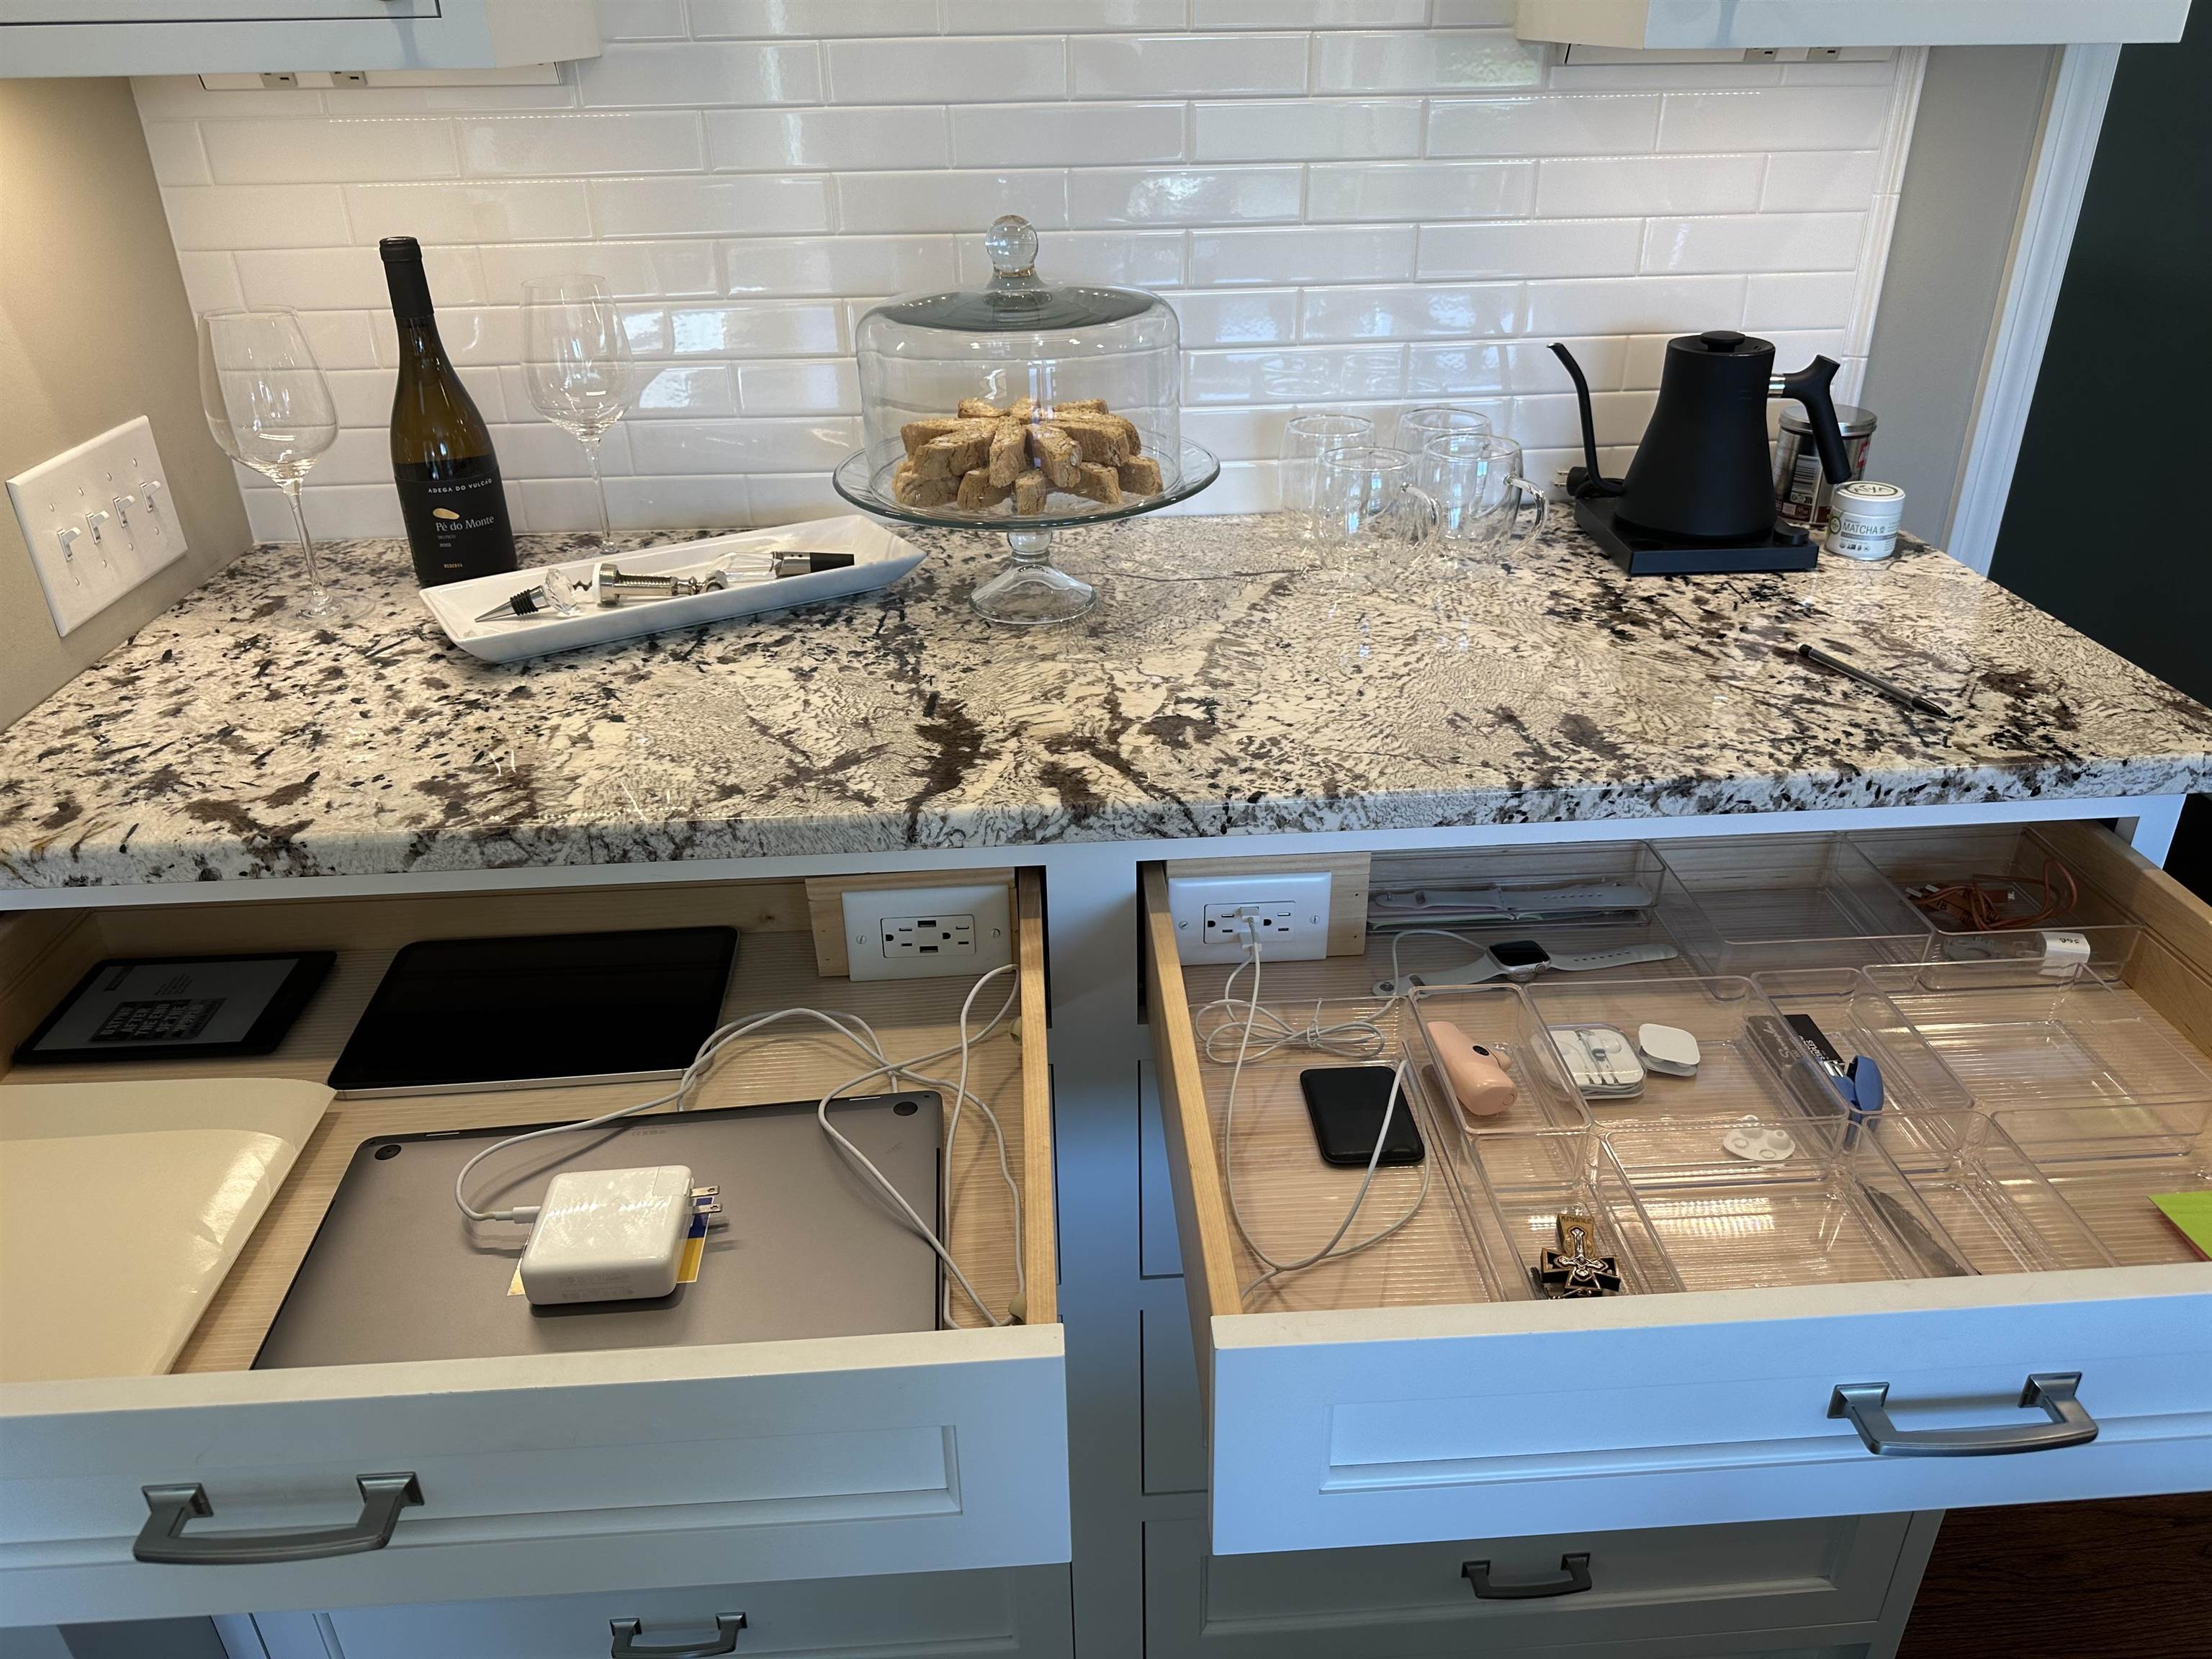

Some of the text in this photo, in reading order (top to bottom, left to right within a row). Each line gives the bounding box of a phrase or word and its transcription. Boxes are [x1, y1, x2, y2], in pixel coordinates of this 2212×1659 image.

[436, 516, 495, 531] Pé do Monte
[1843, 522, 1878, 534] MATCHA
[119, 1007, 151, 1033] AFTER
[1561, 1215, 1593, 1224] JERUSALEM
